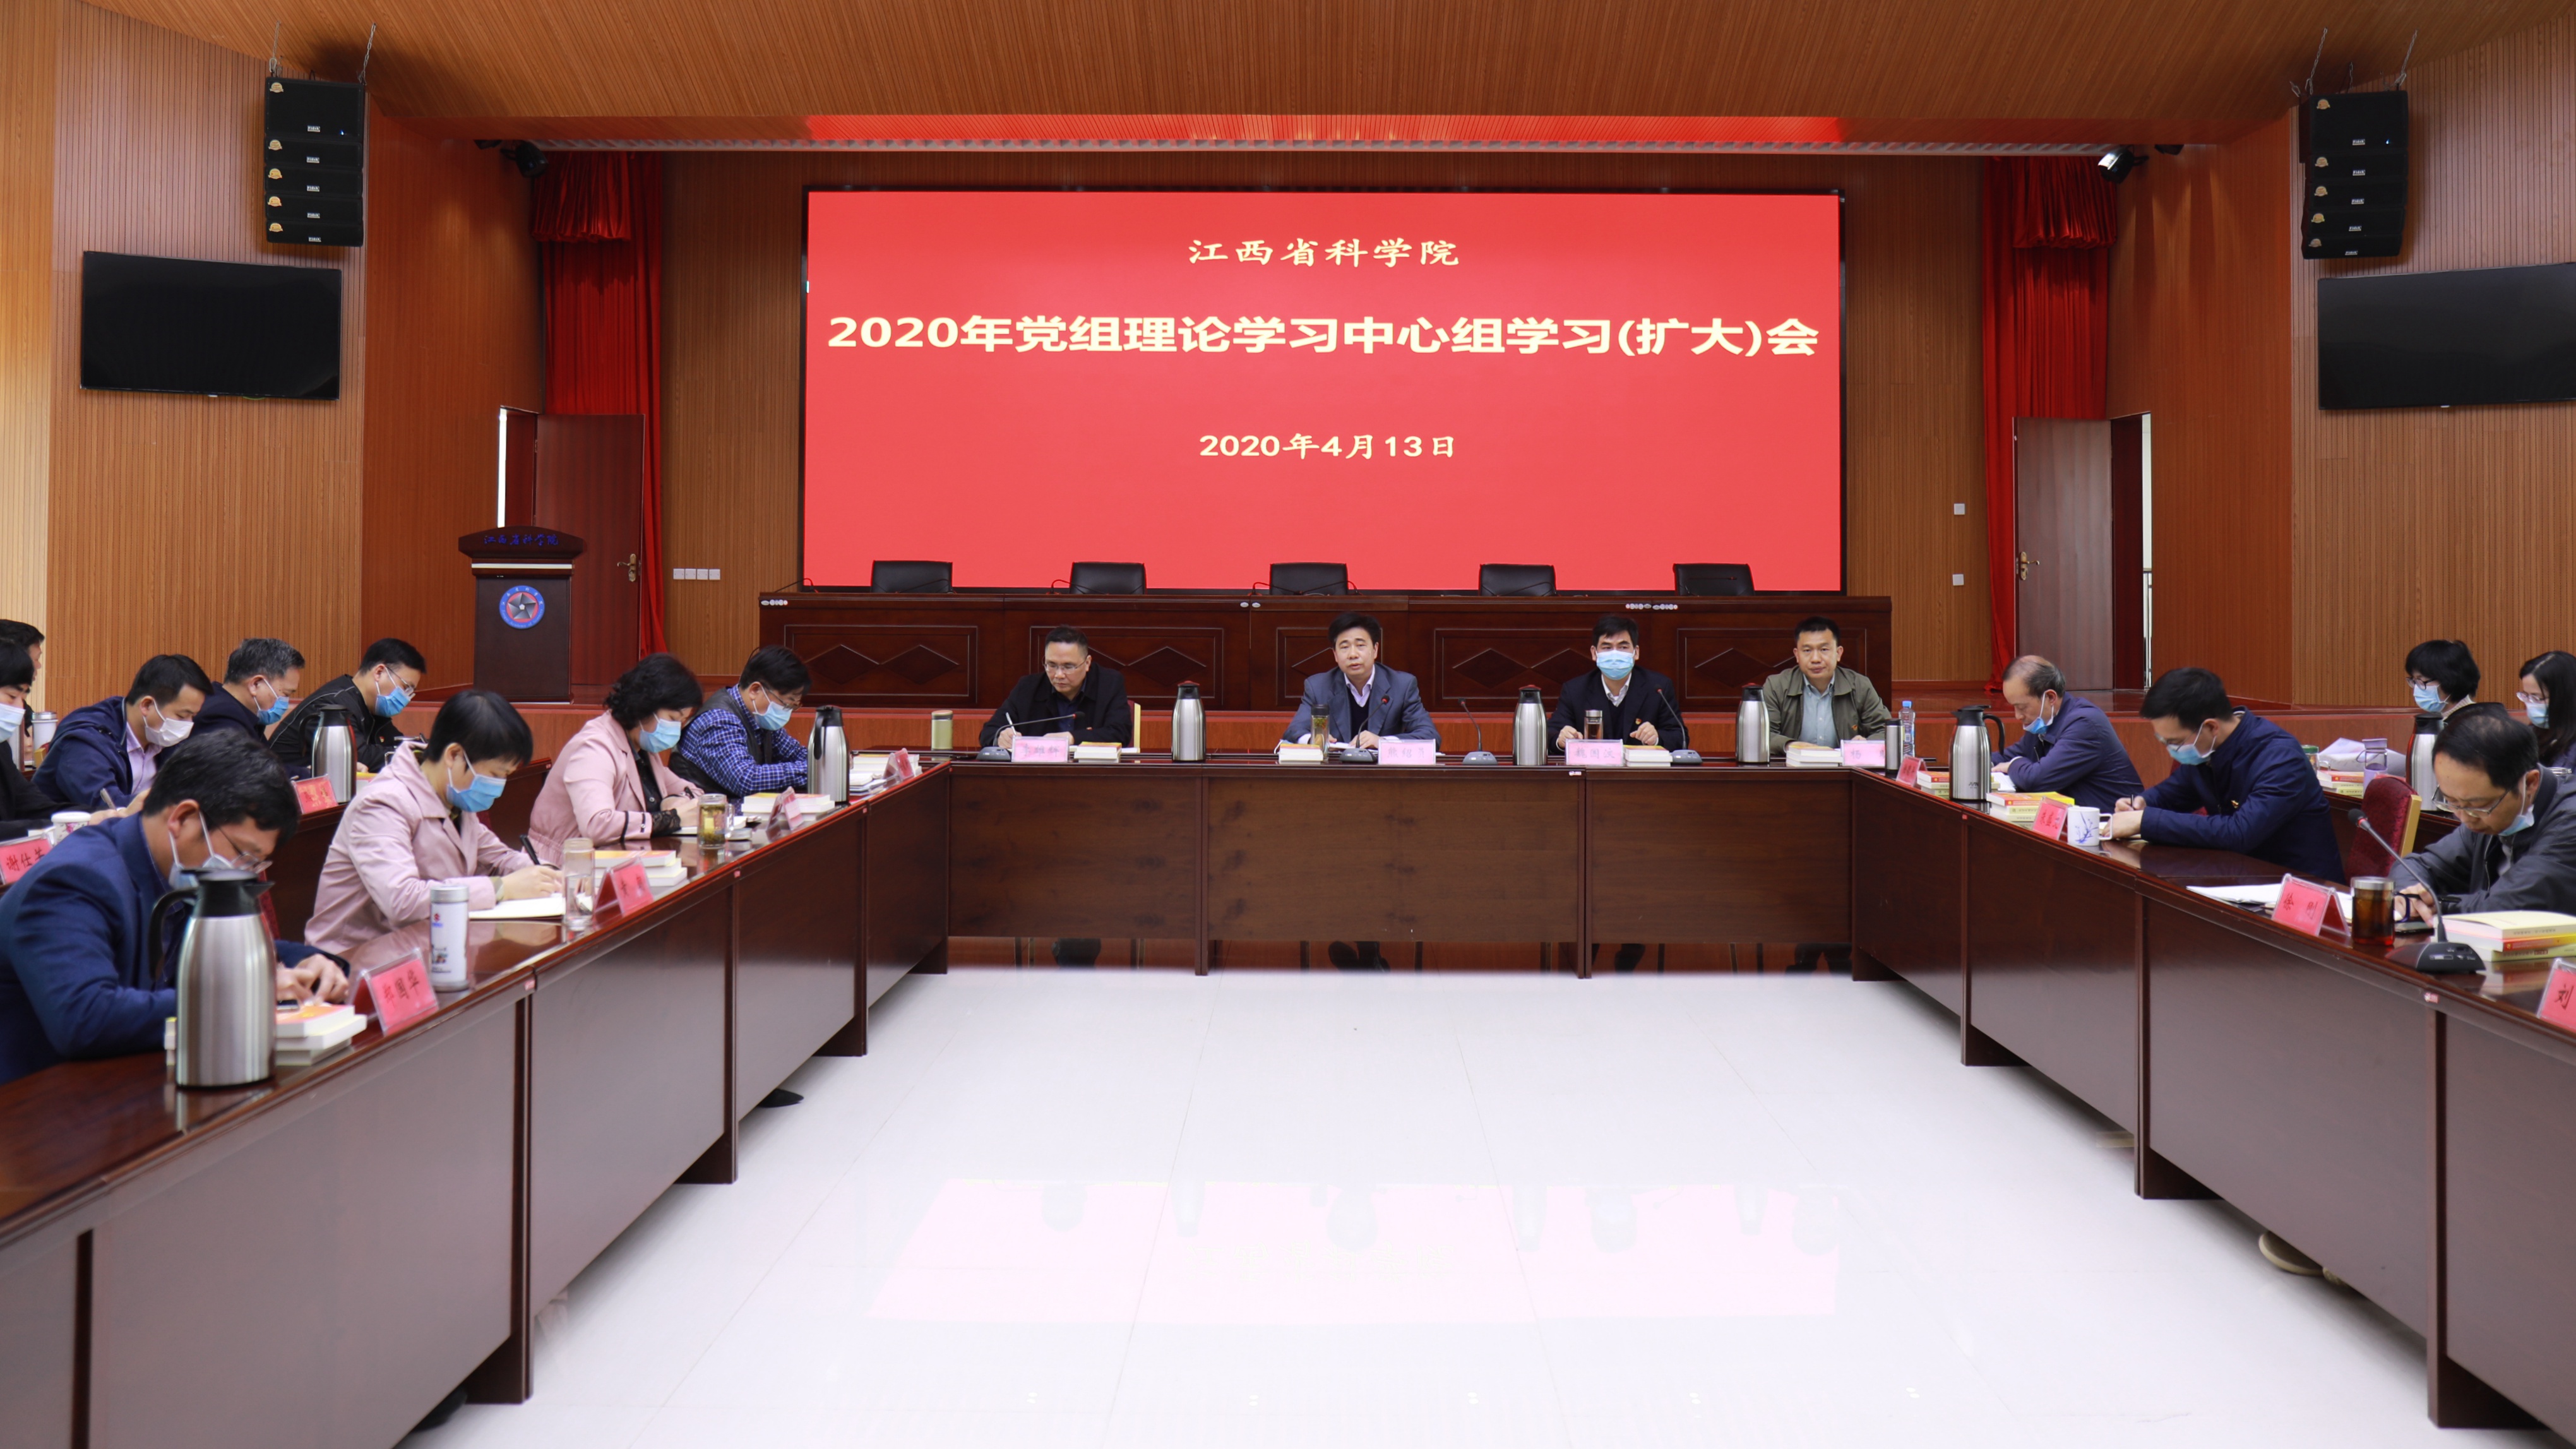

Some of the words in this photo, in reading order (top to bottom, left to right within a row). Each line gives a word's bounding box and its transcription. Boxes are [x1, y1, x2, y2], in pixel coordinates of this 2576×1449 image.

[1189, 237, 1459, 268] 江西省科学院
[828, 314, 1819, 357] 2020年党组理论学习中心组学习(扩大)会
[1200, 432, 1454, 460] 2020年4月13日
[2554, 984, 2574, 1010] 刘
